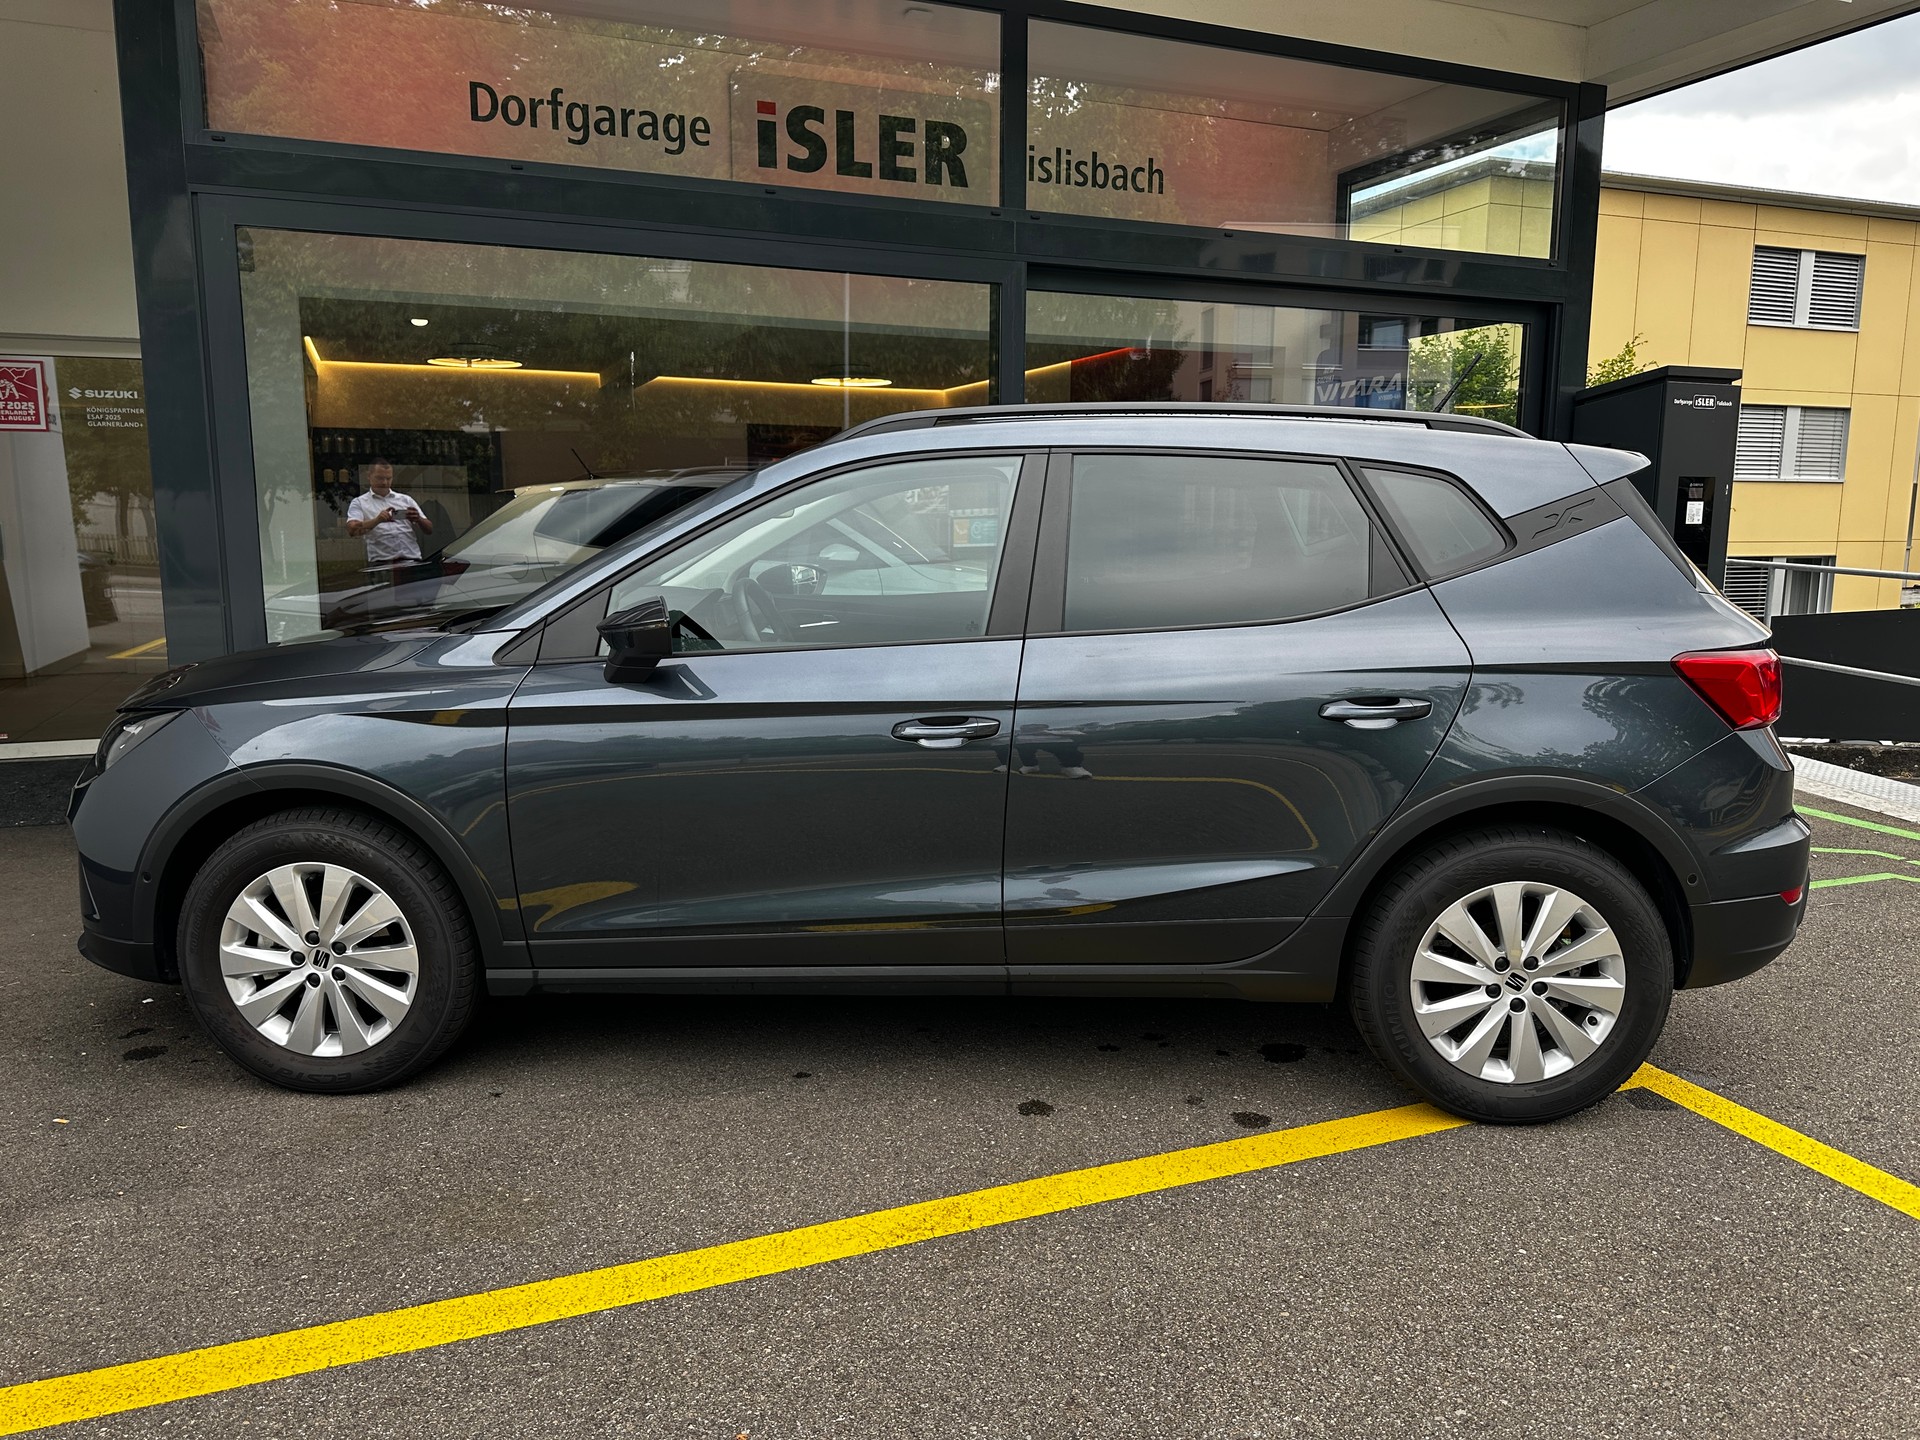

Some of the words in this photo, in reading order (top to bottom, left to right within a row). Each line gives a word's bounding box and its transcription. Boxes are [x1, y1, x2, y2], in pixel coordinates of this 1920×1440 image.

[469, 80, 711, 155] Dorfgarage
[1028, 144, 1164, 194] islisbach
[84, 389, 138, 399] SUZUKI
[1316, 372, 1402, 402] VITARA
[7, 401, 35, 410] 2025
[86, 405, 145, 414] KÖNIGSPARTNER
[383, 867, 437, 946] KUMHO
[1383, 981, 1420, 1064] KUMHO
